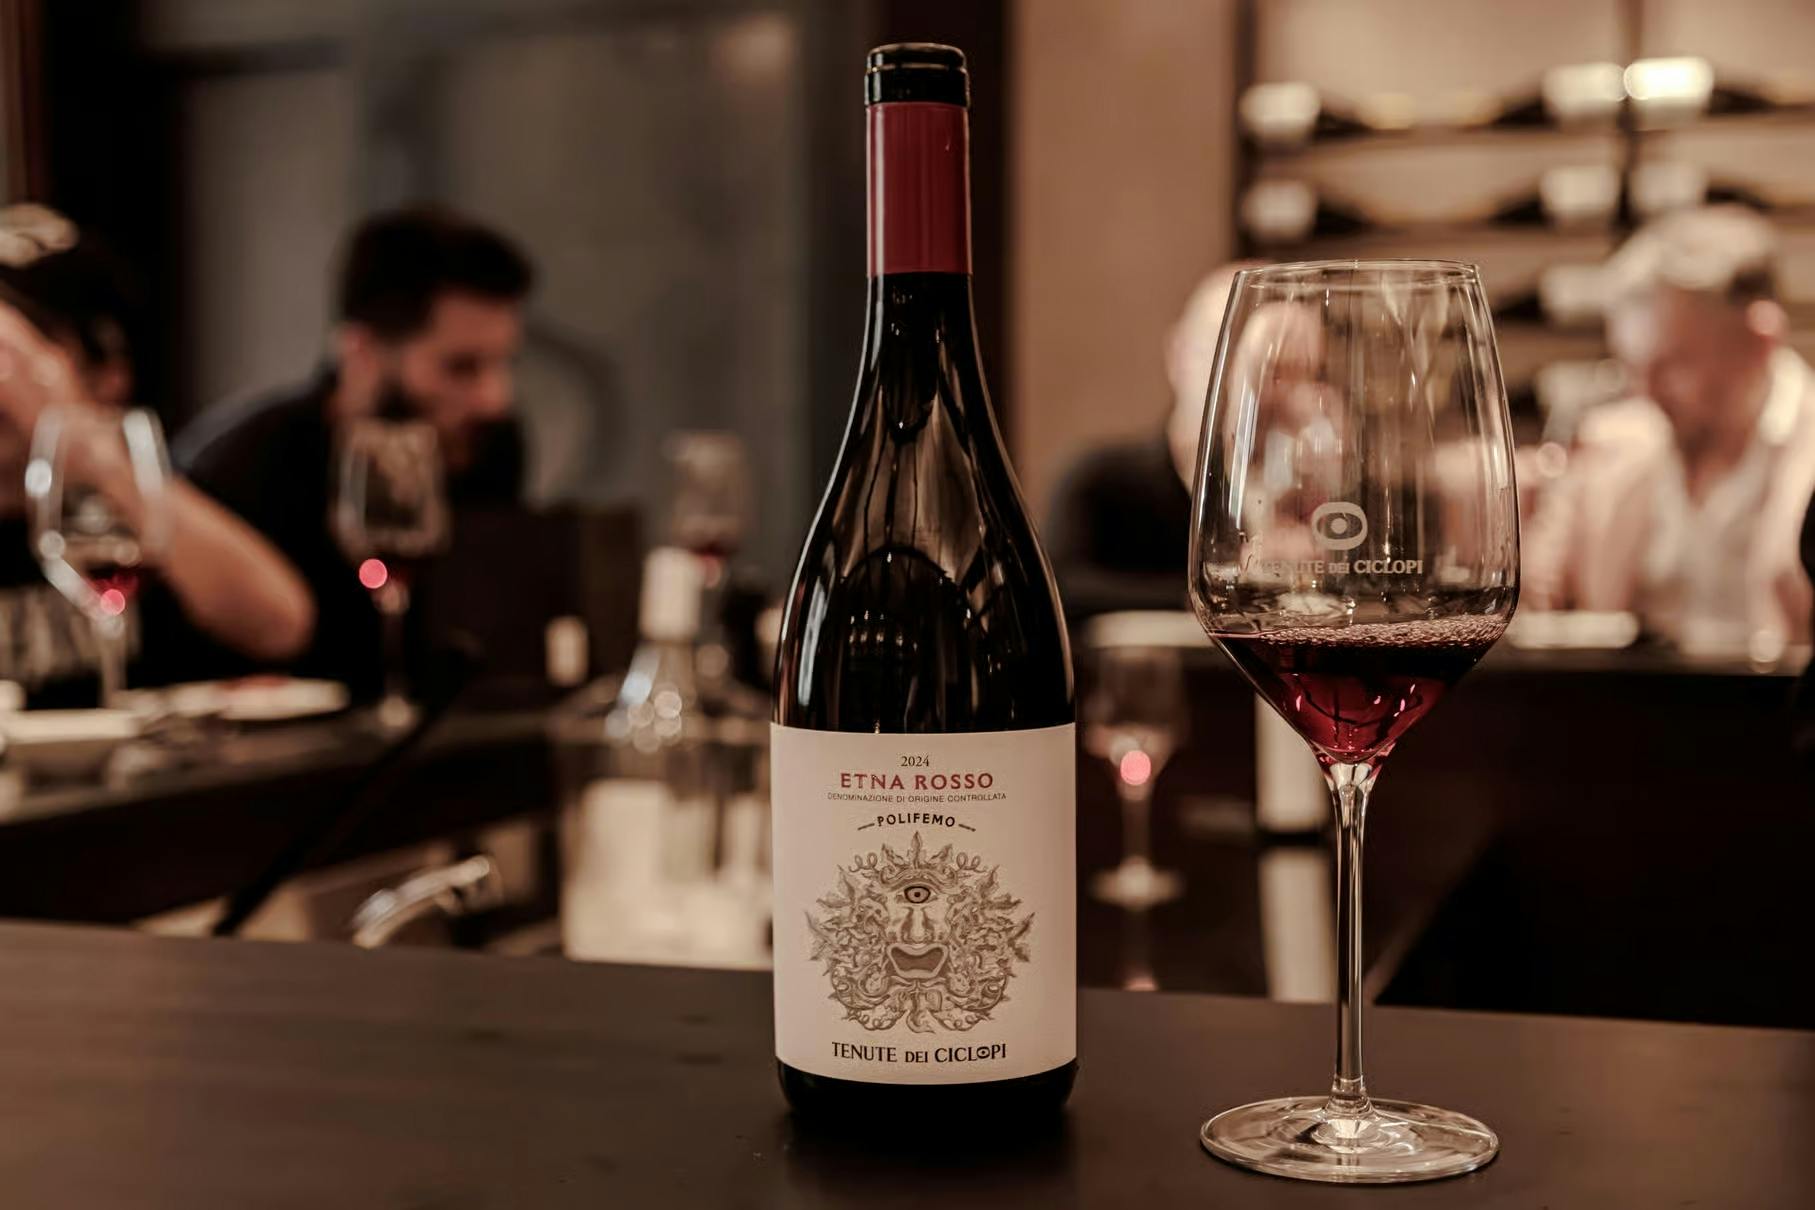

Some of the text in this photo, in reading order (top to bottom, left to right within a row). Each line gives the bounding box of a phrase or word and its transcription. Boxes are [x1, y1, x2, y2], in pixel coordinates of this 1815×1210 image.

[1260, 559, 1423, 575] EUTE DEI CICLOPI
[900, 755, 930, 767] 2024
[840, 772, 993, 790] ETNA ROSSO
[827, 791, 1007, 803] DENOMINAZIONE DI ORIGINE CONTROLLATA
[877, 813, 955, 827] POLIFEMO
[832, 1041, 1007, 1063] TENUTE DEI CICLOPI
